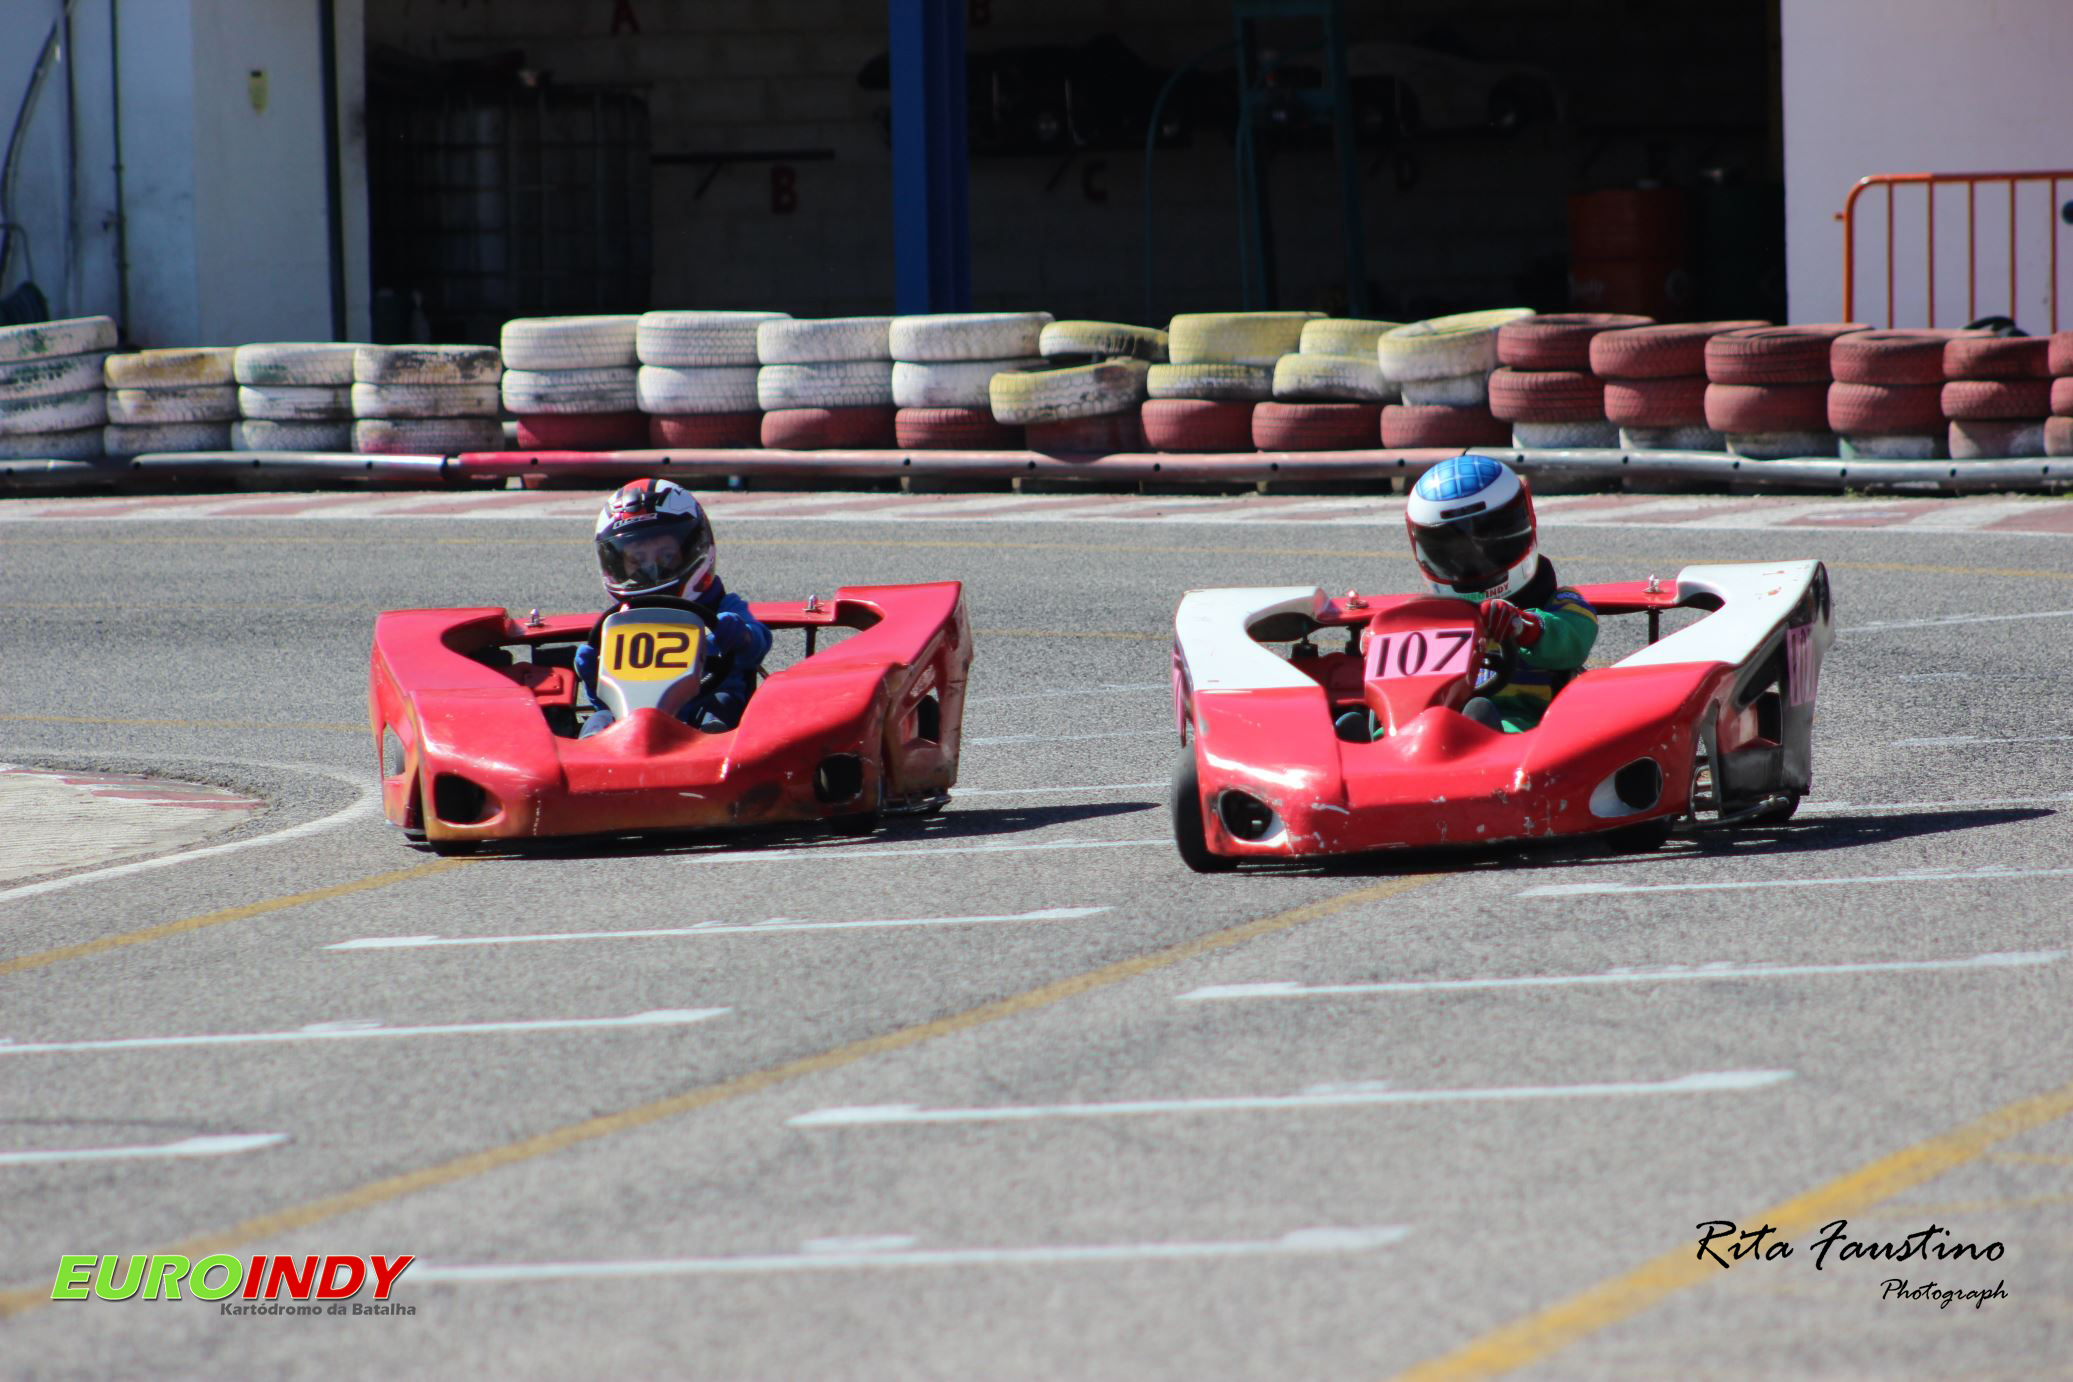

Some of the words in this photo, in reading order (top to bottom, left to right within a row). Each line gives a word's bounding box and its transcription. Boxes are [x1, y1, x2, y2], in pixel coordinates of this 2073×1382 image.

[612, 0, 639, 35] A
[771, 166, 797, 213] B
[1080, 159, 1107, 202] C
[613, 631, 690, 670] 102
[1376, 630, 1473, 677] 107
